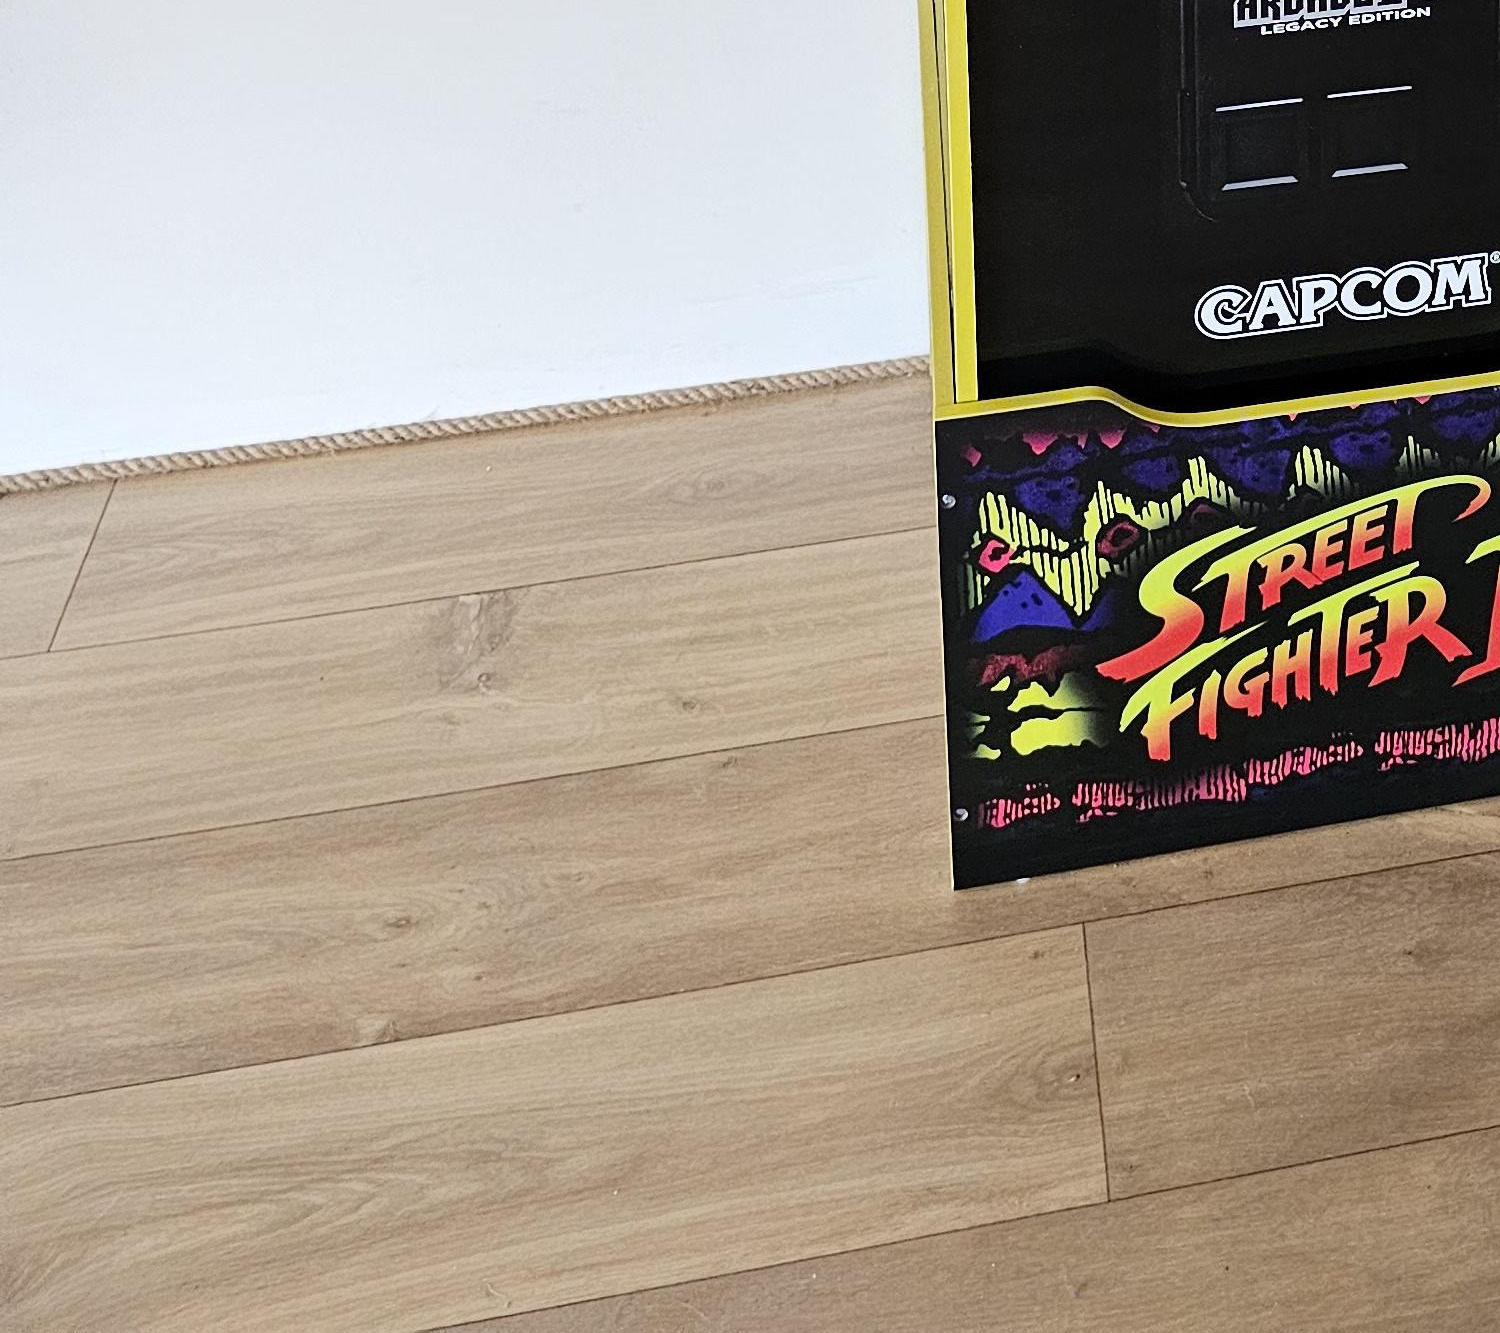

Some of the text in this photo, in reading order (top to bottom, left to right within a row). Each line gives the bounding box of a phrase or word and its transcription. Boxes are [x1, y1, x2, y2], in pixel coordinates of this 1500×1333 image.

[1260, 6, 1431, 35] LEGACY EDITION
[1194, 252, 1492, 339] CAPCOM
[1095, 474, 1492, 683] STREET
[1119, 561, 1473, 761] FIGHTER
